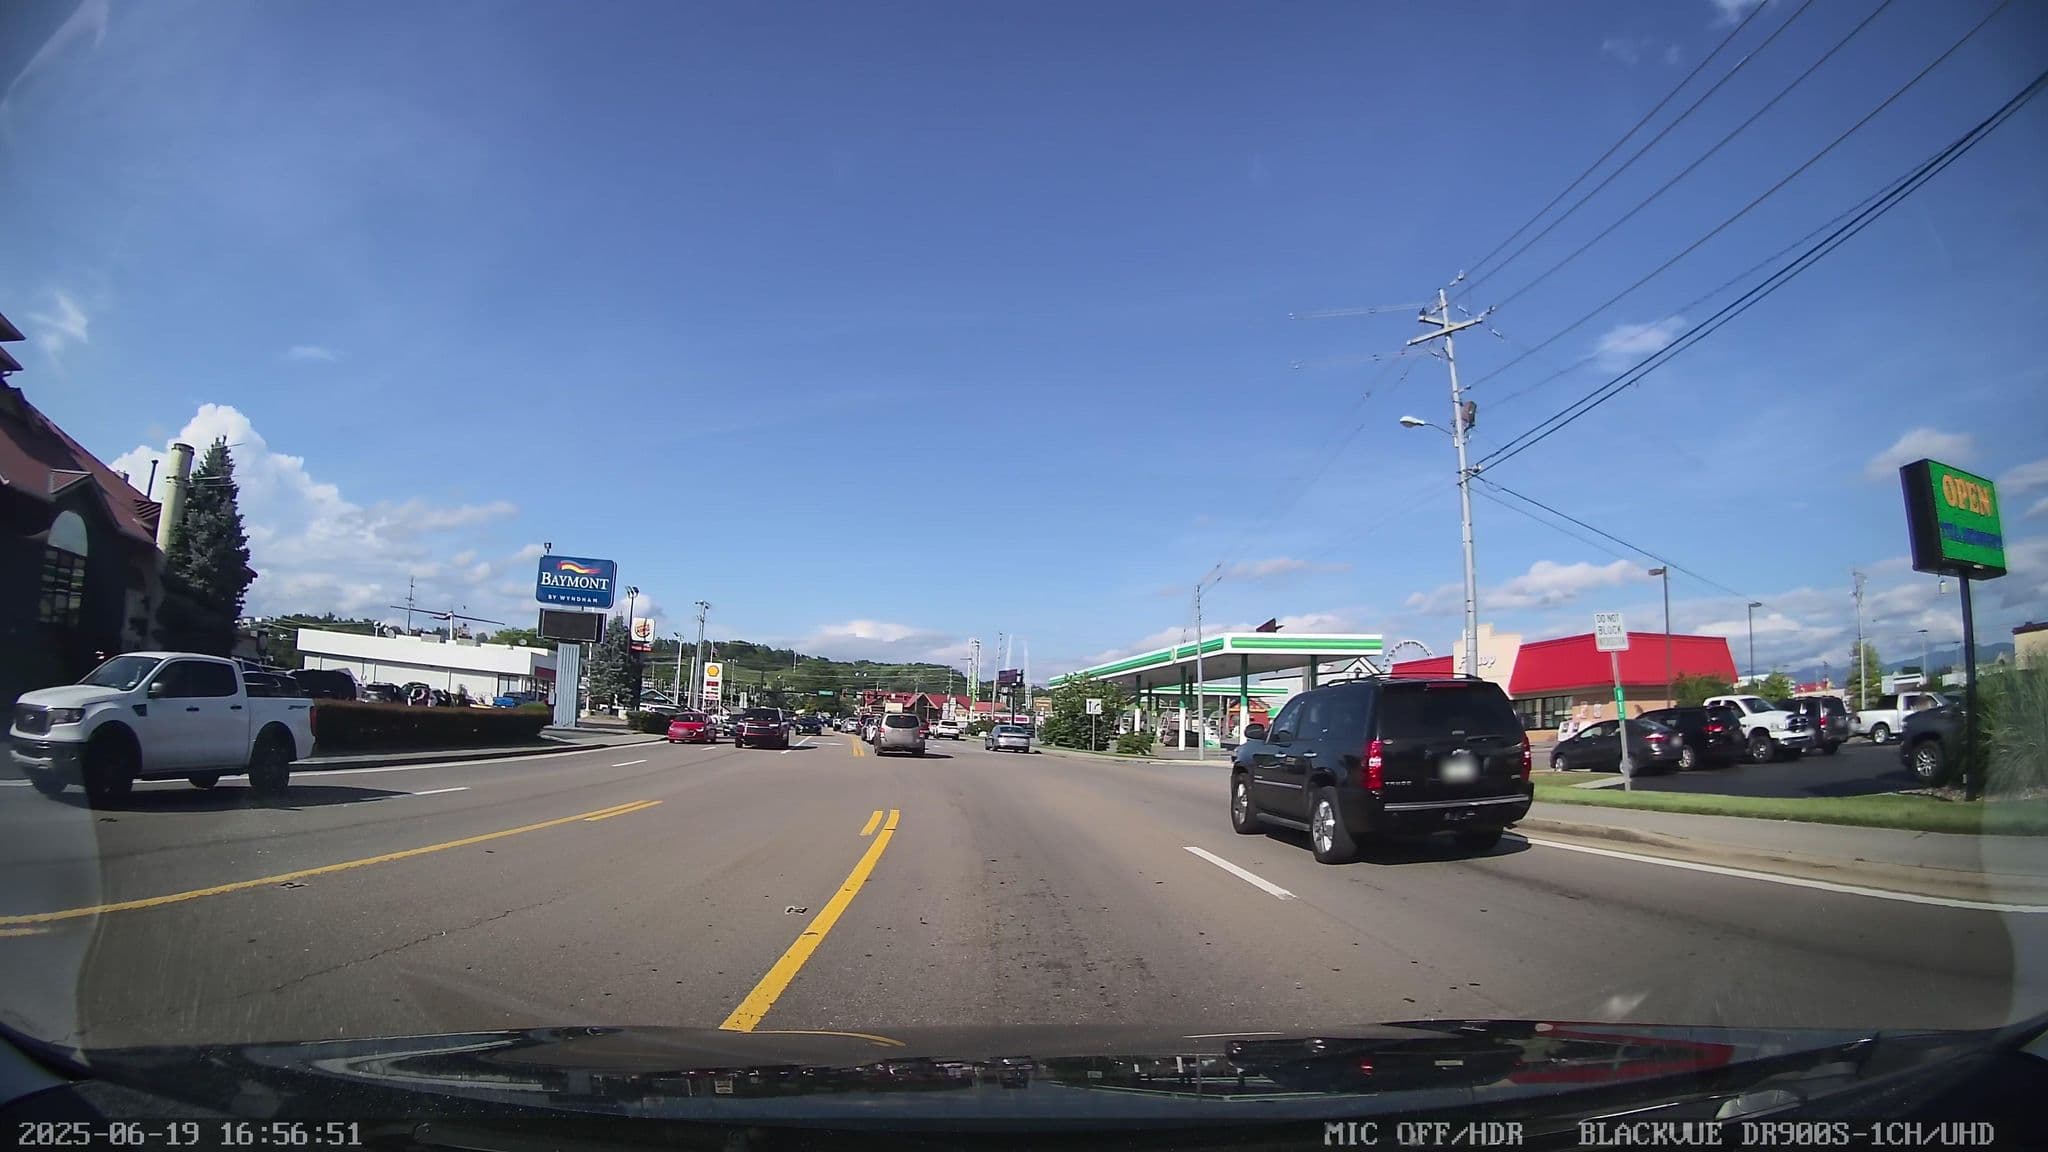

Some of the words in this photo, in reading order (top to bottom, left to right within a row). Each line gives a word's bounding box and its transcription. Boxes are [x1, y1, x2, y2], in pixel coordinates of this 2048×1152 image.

[1942, 474, 1992, 517] OPEN
[541, 571, 609, 590] BAYMONT
[560, 595, 598, 603] WYNDHAM
[1596, 614, 1606, 623] DO
[1607, 613, 1620, 622] NOT
[1598, 625, 1621, 635] BLOCK
